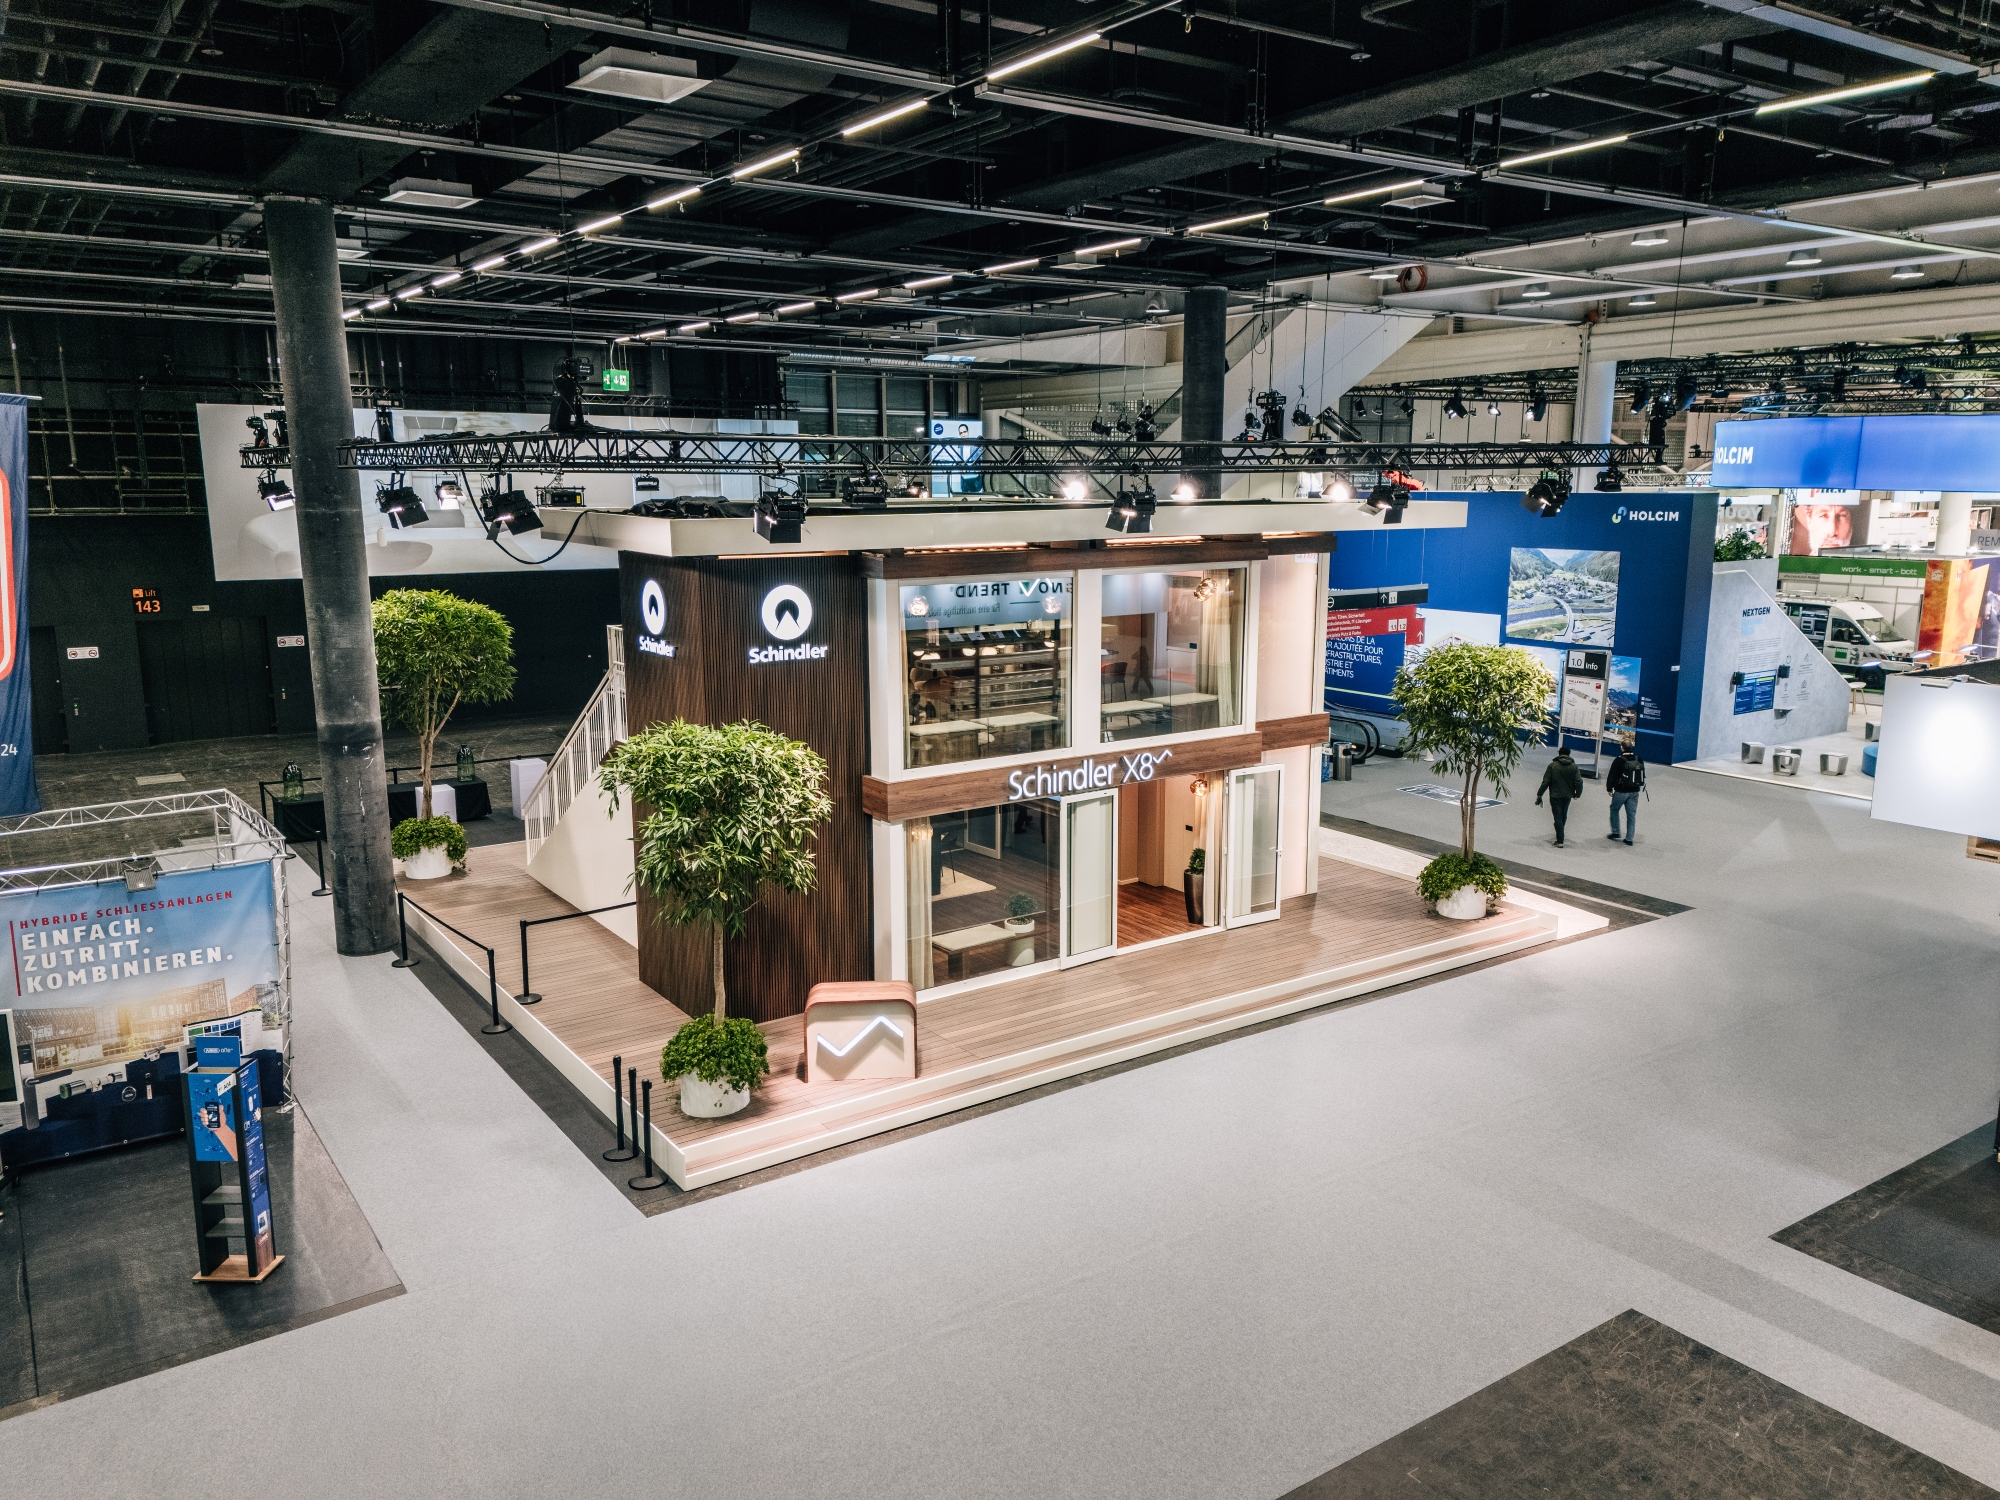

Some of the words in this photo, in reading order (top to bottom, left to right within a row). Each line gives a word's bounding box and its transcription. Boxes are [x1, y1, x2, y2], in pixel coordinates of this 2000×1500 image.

[1630, 510, 1680, 522] HOLCIM
[1900, 568, 1918, 576] bott
[144, 589, 156, 597] Lift
[136, 600, 160, 613] 143
[1742, 606, 1771, 618] NEXTGEN
[639, 636, 675, 658] Schindler
[1366, 637, 1375, 645] LA
[749, 644, 828, 664] Schindler
[1334, 641, 1363, 653] AJOUTÉE
[1364, 646, 1384, 655] POUR
[1345, 661, 1353, 669] ET
[1571, 658, 1582, 667] 1.0
[1008, 759, 1116, 800] Schindler
[1121, 752, 1154, 783] X8
[20, 912, 88, 930] HYBRIDE
[96, 890, 232, 918] SCHLIESSANLAGEN
[22, 918, 154, 950] EINFACH.
[23, 939, 150, 972] ZUTRITT.
[26, 946, 234, 994] KOMBINIEREN.
